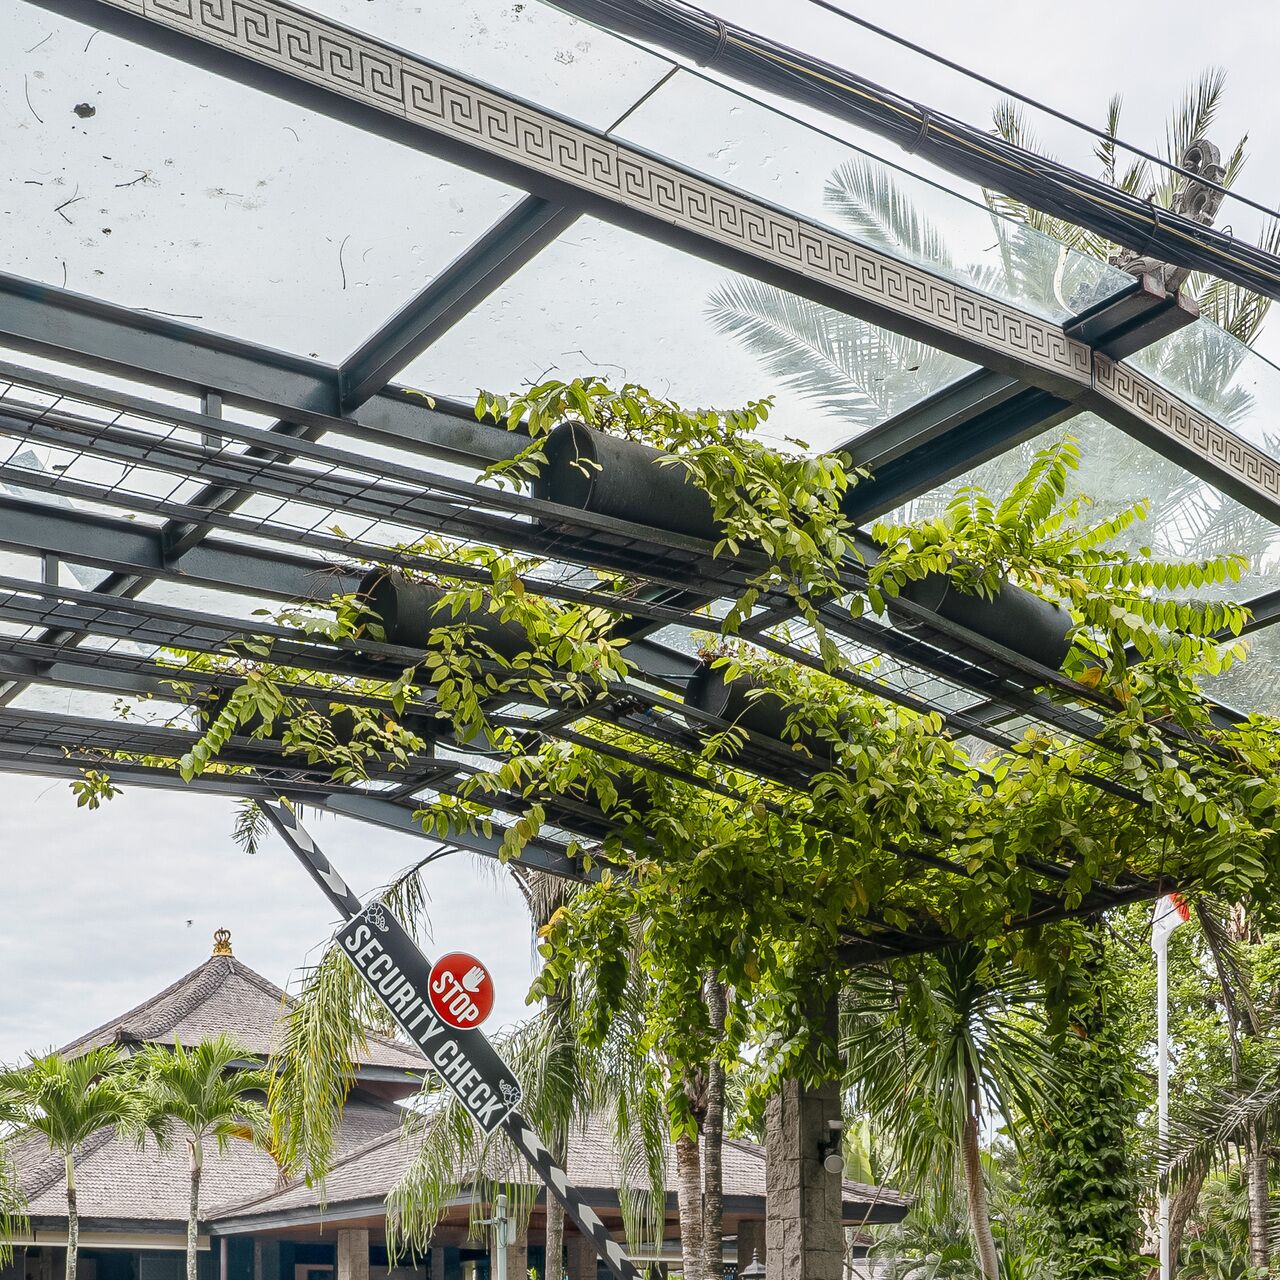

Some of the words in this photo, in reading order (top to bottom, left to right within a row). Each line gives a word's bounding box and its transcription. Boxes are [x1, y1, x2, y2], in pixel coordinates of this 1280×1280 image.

[345, 924, 446, 1046] SECURITY
[433, 1040, 505, 1127] CHECK
[432, 970, 480, 1024] STOP
